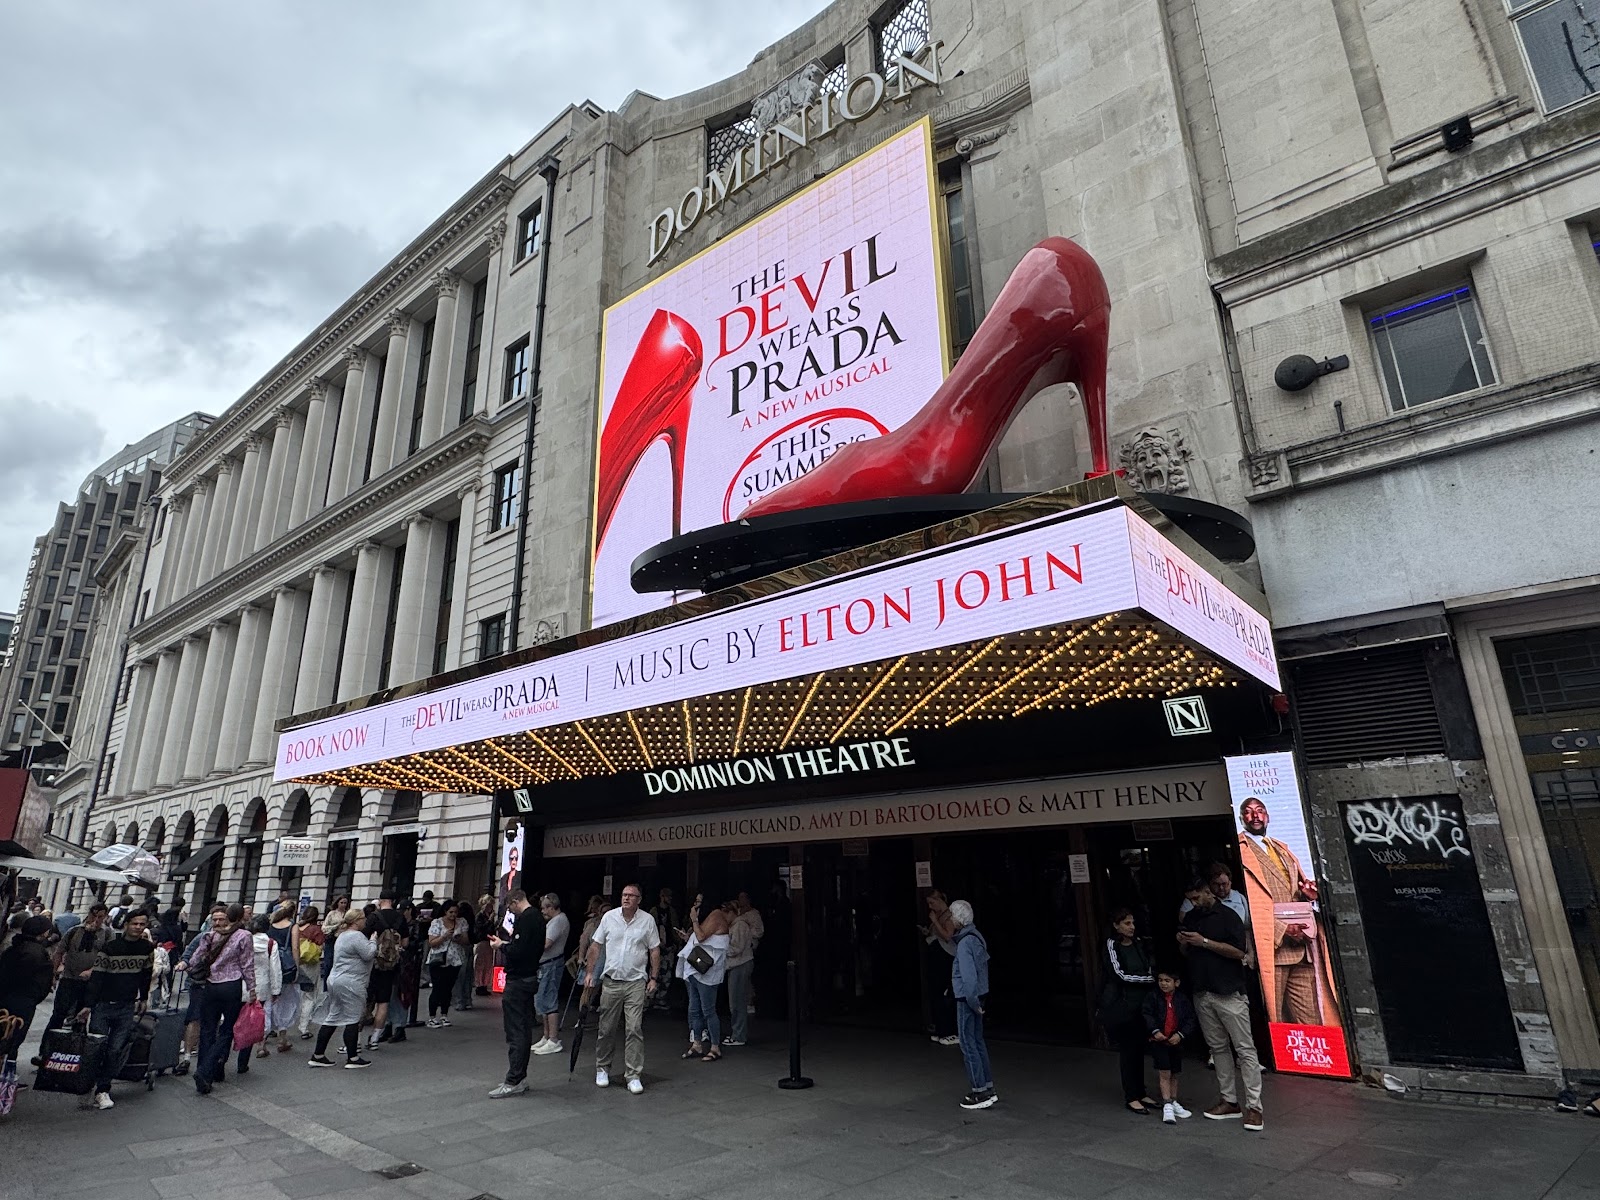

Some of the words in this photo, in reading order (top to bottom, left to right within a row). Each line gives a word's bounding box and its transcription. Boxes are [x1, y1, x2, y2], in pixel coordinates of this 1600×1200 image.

[647, 40, 944, 268] DOMINION
[715, 232, 898, 359] DEVIL
[732, 259, 786, 305] THE
[758, 296, 861, 362] WEARS
[727, 311, 907, 418] PRADA
[740, 416, 752, 432] A
[757, 396, 797, 425] NEW
[802, 357, 893, 405] MUSICAL
[772, 423, 831, 462] THIS
[612, 638, 711, 690] MUSIC
[726, 624, 765, 665] BY
[778, 586, 912, 653] ELTON
[934, 543, 1084, 630] JOHN
[1147, 551, 1167, 580] THE
[1164, 555, 1215, 622] DEVIL
[1209, 598, 1233, 627] WEARS
[1231, 606, 1273, 661] PRADA
[401, 714, 416, 728] THE
[415, 697, 464, 730] DEVIL
[463, 695, 492, 712] WEARS
[493, 673, 560, 712] PRADA
[502, 711, 508, 720] A
[509, 707, 526, 719] NEW
[526, 700, 560, 715] MUSICAL
[286, 735, 327, 764] BOOK
[329, 724, 369, 754] NOW
[1250, 760, 1269, 768] HER
[644, 756, 775, 795] DOMINION
[776, 737, 915, 780] THEATRE
[1243, 768, 1278, 778] RIGHT
[1246, 778, 1279, 788] HAND
[1253, 787, 1274, 795] MAN
[553, 834, 595, 848] VANESSA
[659, 823, 716, 841] GEORGIE
[808, 811, 844, 830] AMY
[850, 810, 868, 827] DI
[875, 797, 1011, 825] BARTOLOMEO
[1018, 795, 1035, 814] &
[1041, 789, 1105, 812] MATT
[1114, 780, 1207, 807] HENRY
[283, 852, 308, 860] express
[50, 1052, 80, 1062] SPORTS
[1286, 1035, 1330, 1049] DEVIL
[1293, 1048, 1333, 1064] PRADA
[46, 1060, 79, 1072] DIRECT
